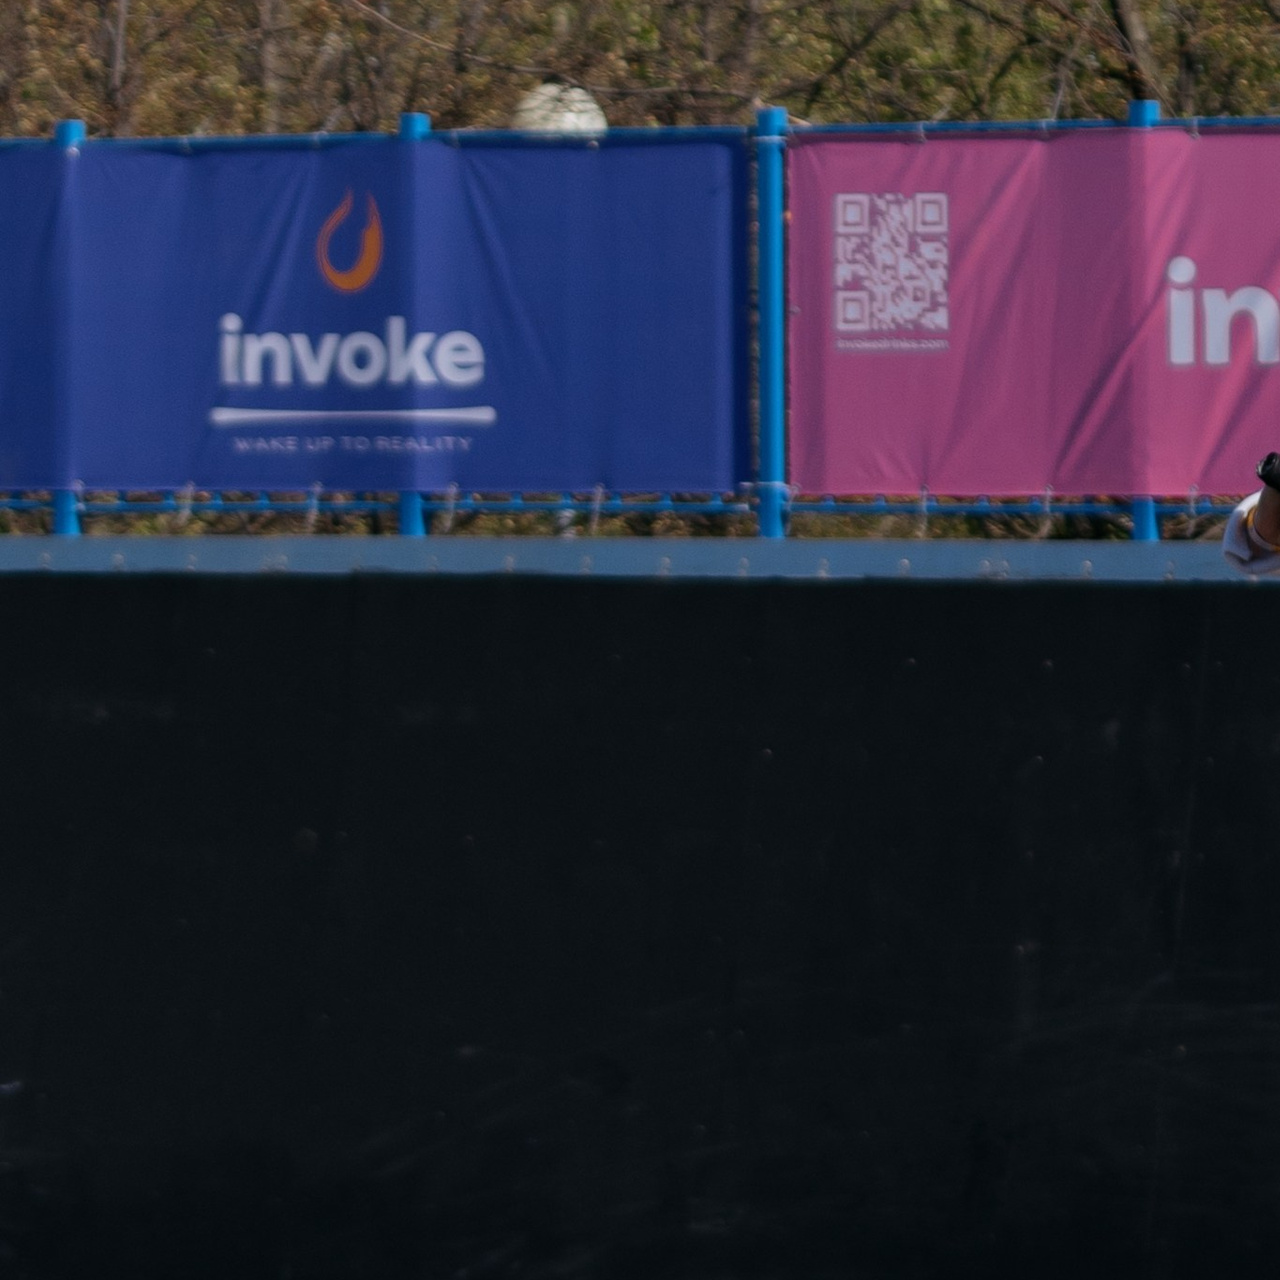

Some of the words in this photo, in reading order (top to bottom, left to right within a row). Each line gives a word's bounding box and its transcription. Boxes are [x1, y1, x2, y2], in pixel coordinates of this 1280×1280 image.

[220, 312, 486, 386] invoke
[233, 435, 299, 452] WAKE
[304, 435, 335, 452] UP
[340, 435, 371, 452] TO
[374, 435, 472, 452] REALITY
